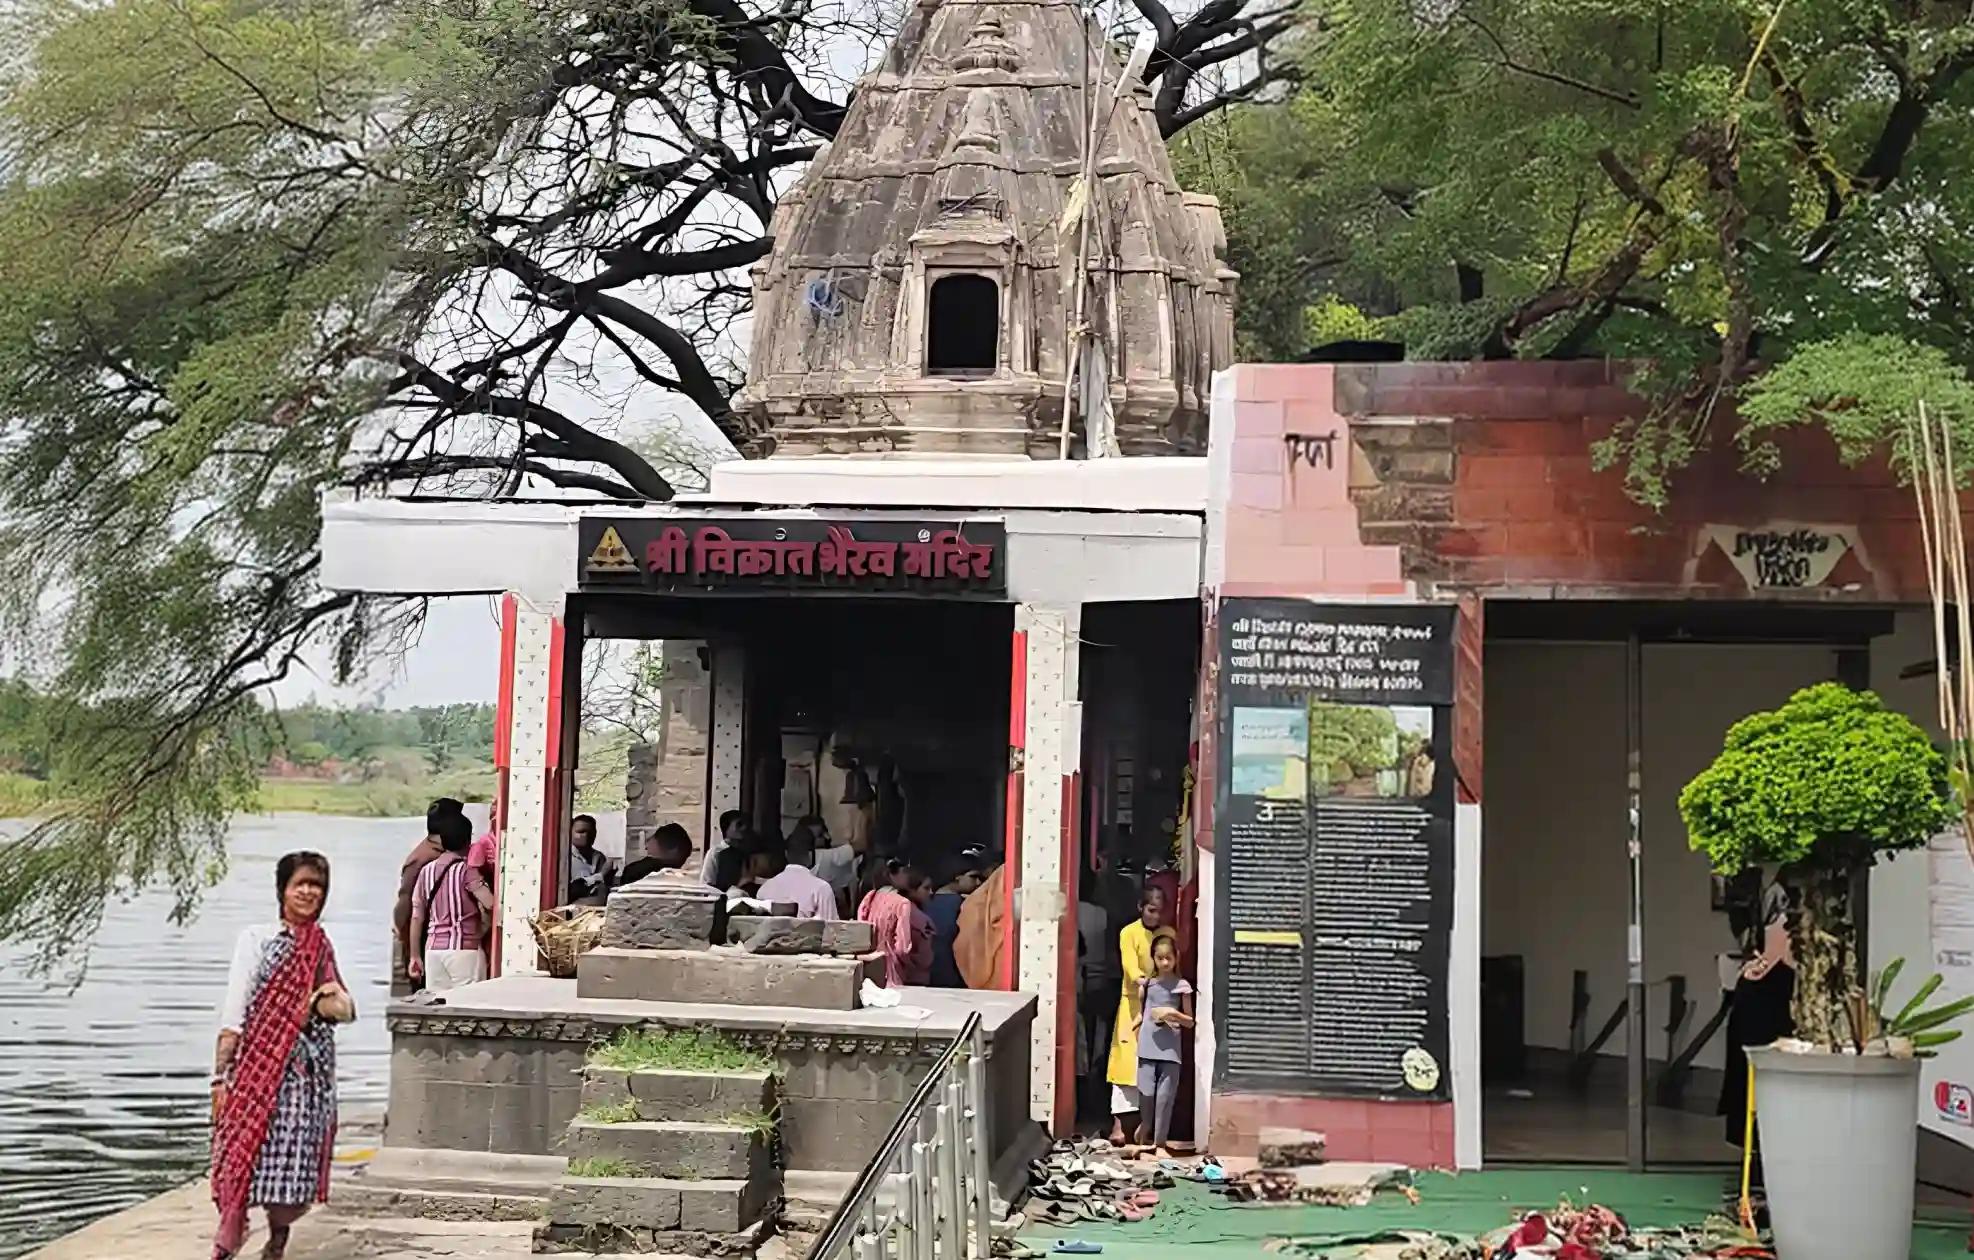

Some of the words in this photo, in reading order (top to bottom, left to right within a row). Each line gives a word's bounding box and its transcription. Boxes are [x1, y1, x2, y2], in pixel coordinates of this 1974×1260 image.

[646, 526, 689, 574] श्री
[819, 525, 899, 577] भैरव
[901, 528, 993, 579] मंदिर
